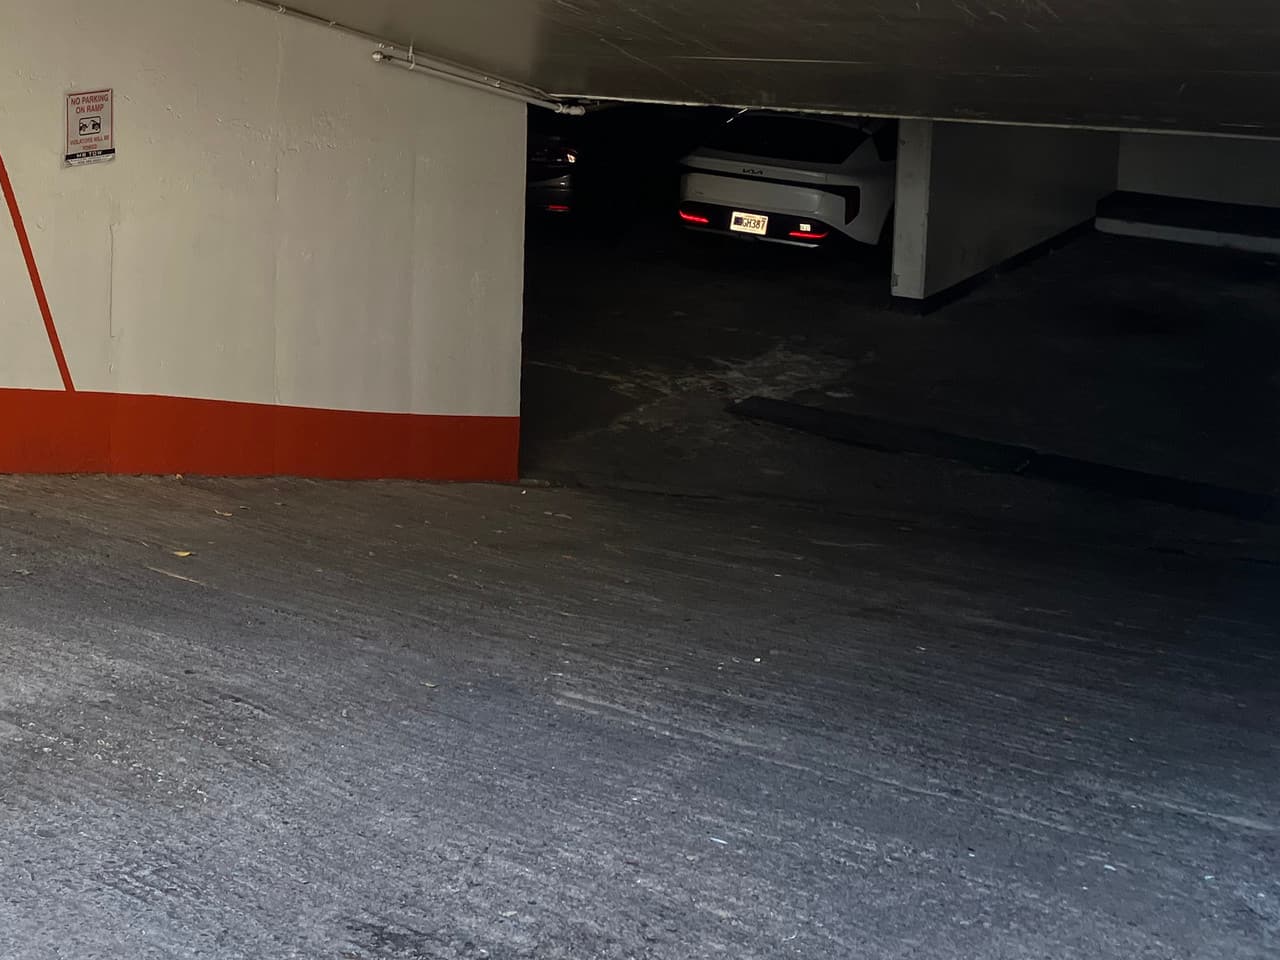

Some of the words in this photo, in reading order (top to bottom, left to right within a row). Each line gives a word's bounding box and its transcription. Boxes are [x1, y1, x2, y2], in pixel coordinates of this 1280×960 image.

[71, 97, 80, 105] NO
[82, 94, 109, 104] PARKING
[86, 104, 104, 113] RAMP
